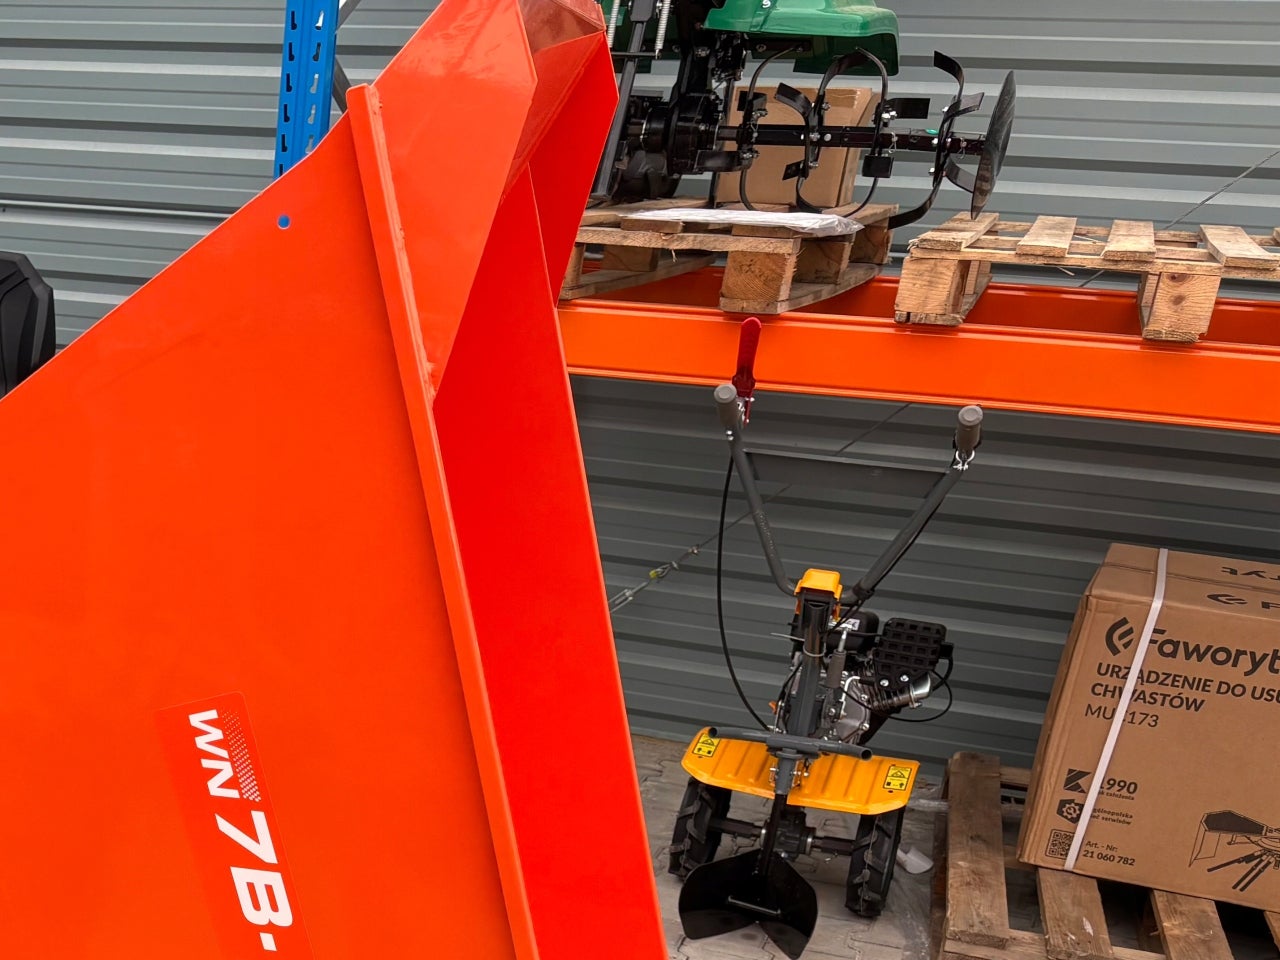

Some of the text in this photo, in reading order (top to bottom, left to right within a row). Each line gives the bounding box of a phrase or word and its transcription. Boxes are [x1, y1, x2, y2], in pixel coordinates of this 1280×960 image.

[1096, 662, 1214, 693] URZĄDZENIE
[1216, 680, 1247, 698] DO
[1084, 703, 1160, 728] MU173
[188, 709, 240, 799] WN
[1083, 849, 1136, 866] 21 060 782
[1086, 841, 1099, 849] Art.
